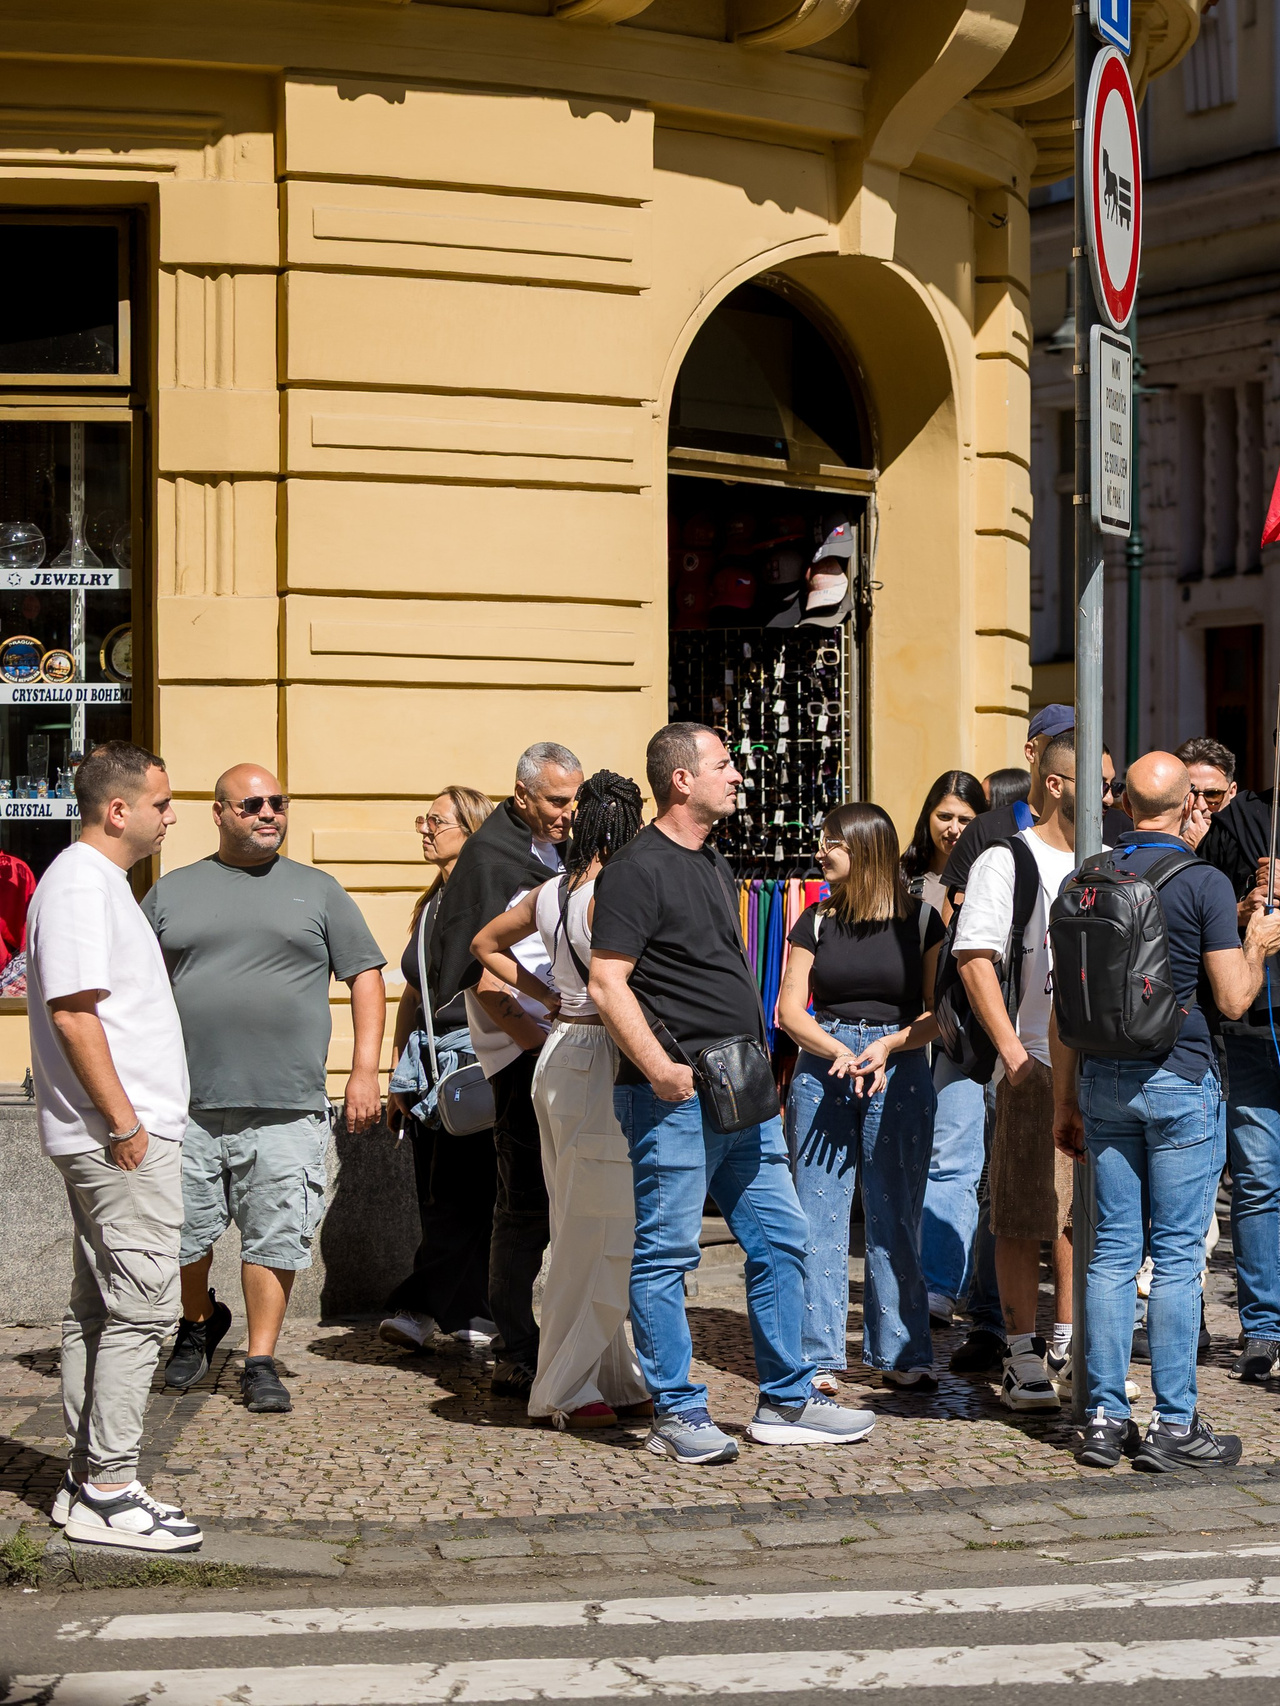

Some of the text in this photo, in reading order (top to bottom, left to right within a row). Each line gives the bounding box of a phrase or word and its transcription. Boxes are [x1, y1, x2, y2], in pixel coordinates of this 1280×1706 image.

[30, 573, 114, 586] JEWELRY
[12, 688, 73, 702] CRYSTALLO
[75, 688, 87, 702] DI
[5, 803, 53, 817] CRYSTAL
